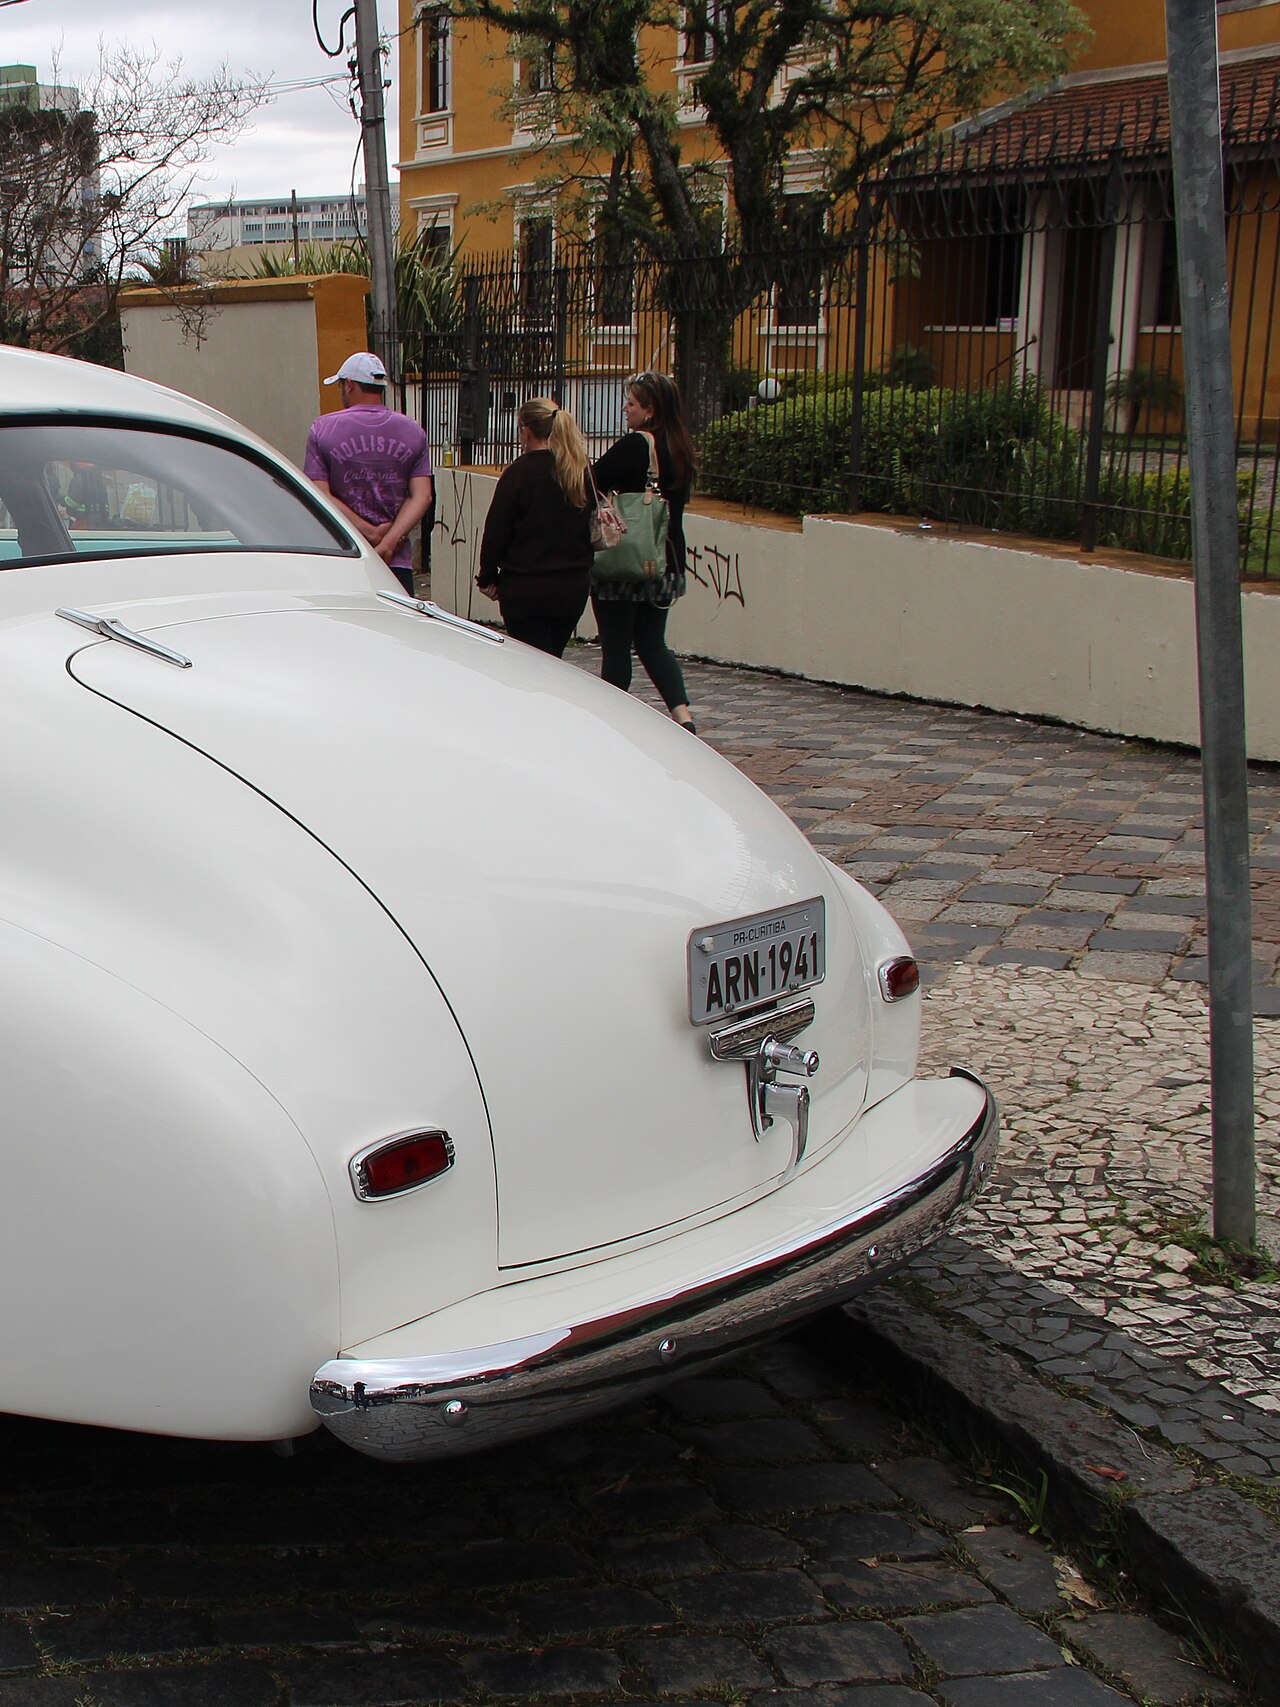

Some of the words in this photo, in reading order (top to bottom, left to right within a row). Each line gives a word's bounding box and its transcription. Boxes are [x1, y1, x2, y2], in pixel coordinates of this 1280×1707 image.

[330, 435, 413, 465] HOLLISTER
[343, 468, 399, 484] California
[733, 920, 786, 945] PR-CURITIBA
